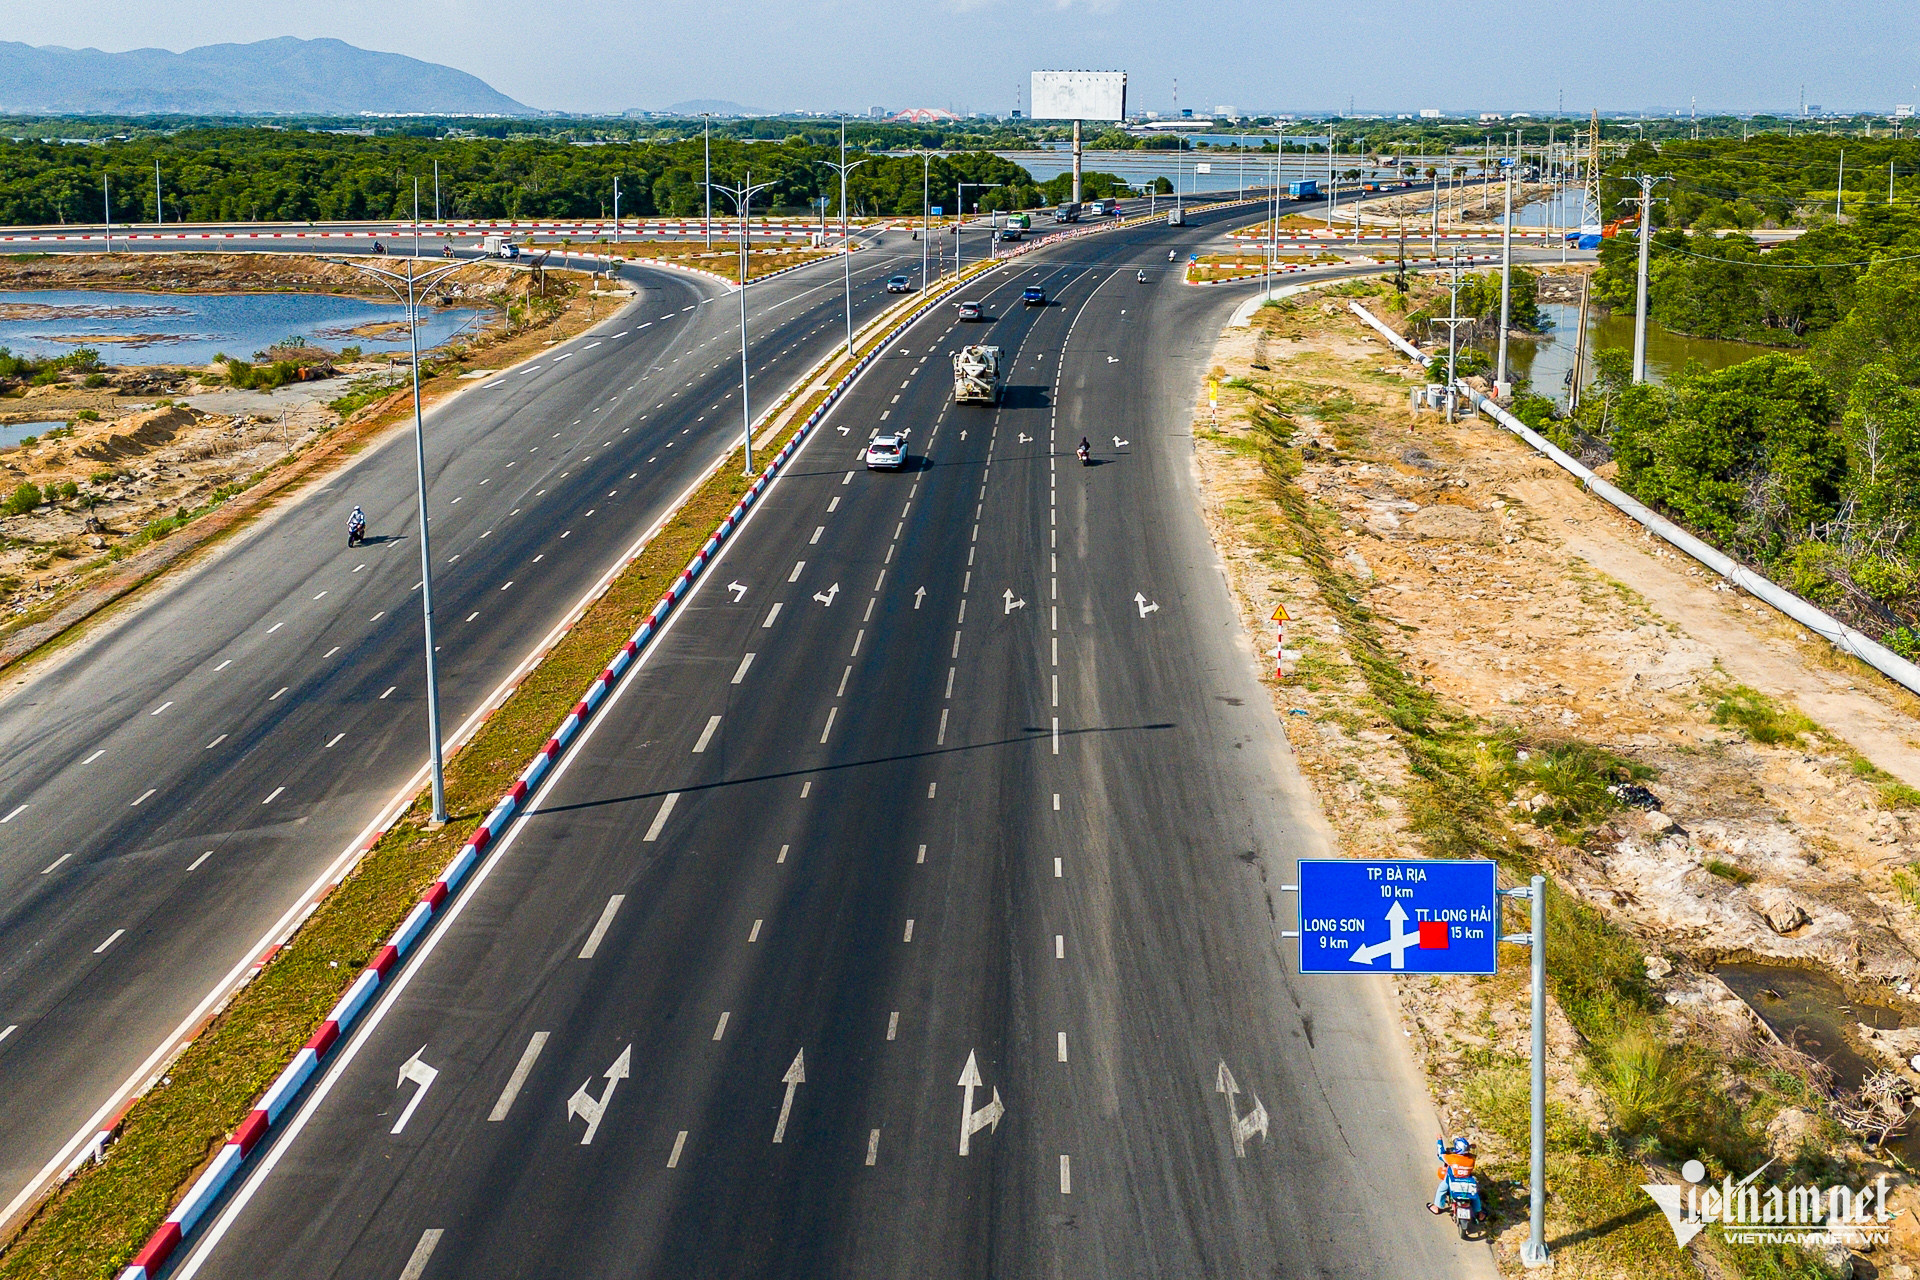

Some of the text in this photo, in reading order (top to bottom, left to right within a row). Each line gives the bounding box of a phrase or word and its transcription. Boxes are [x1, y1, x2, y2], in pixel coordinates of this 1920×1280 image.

[1386, 865, 1403, 881] BÀ
[1406, 868, 1427, 884] RỊA
[1380, 885, 1414, 898] 10 km
[1434, 909, 1467, 922] LONG
[1470, 905, 1491, 922] HẢI
[1304, 918, 1365, 932] LONG SƠN
[1450, 926, 1484, 939] 15 km
[1319, 935, 1349, 949] 9 km
